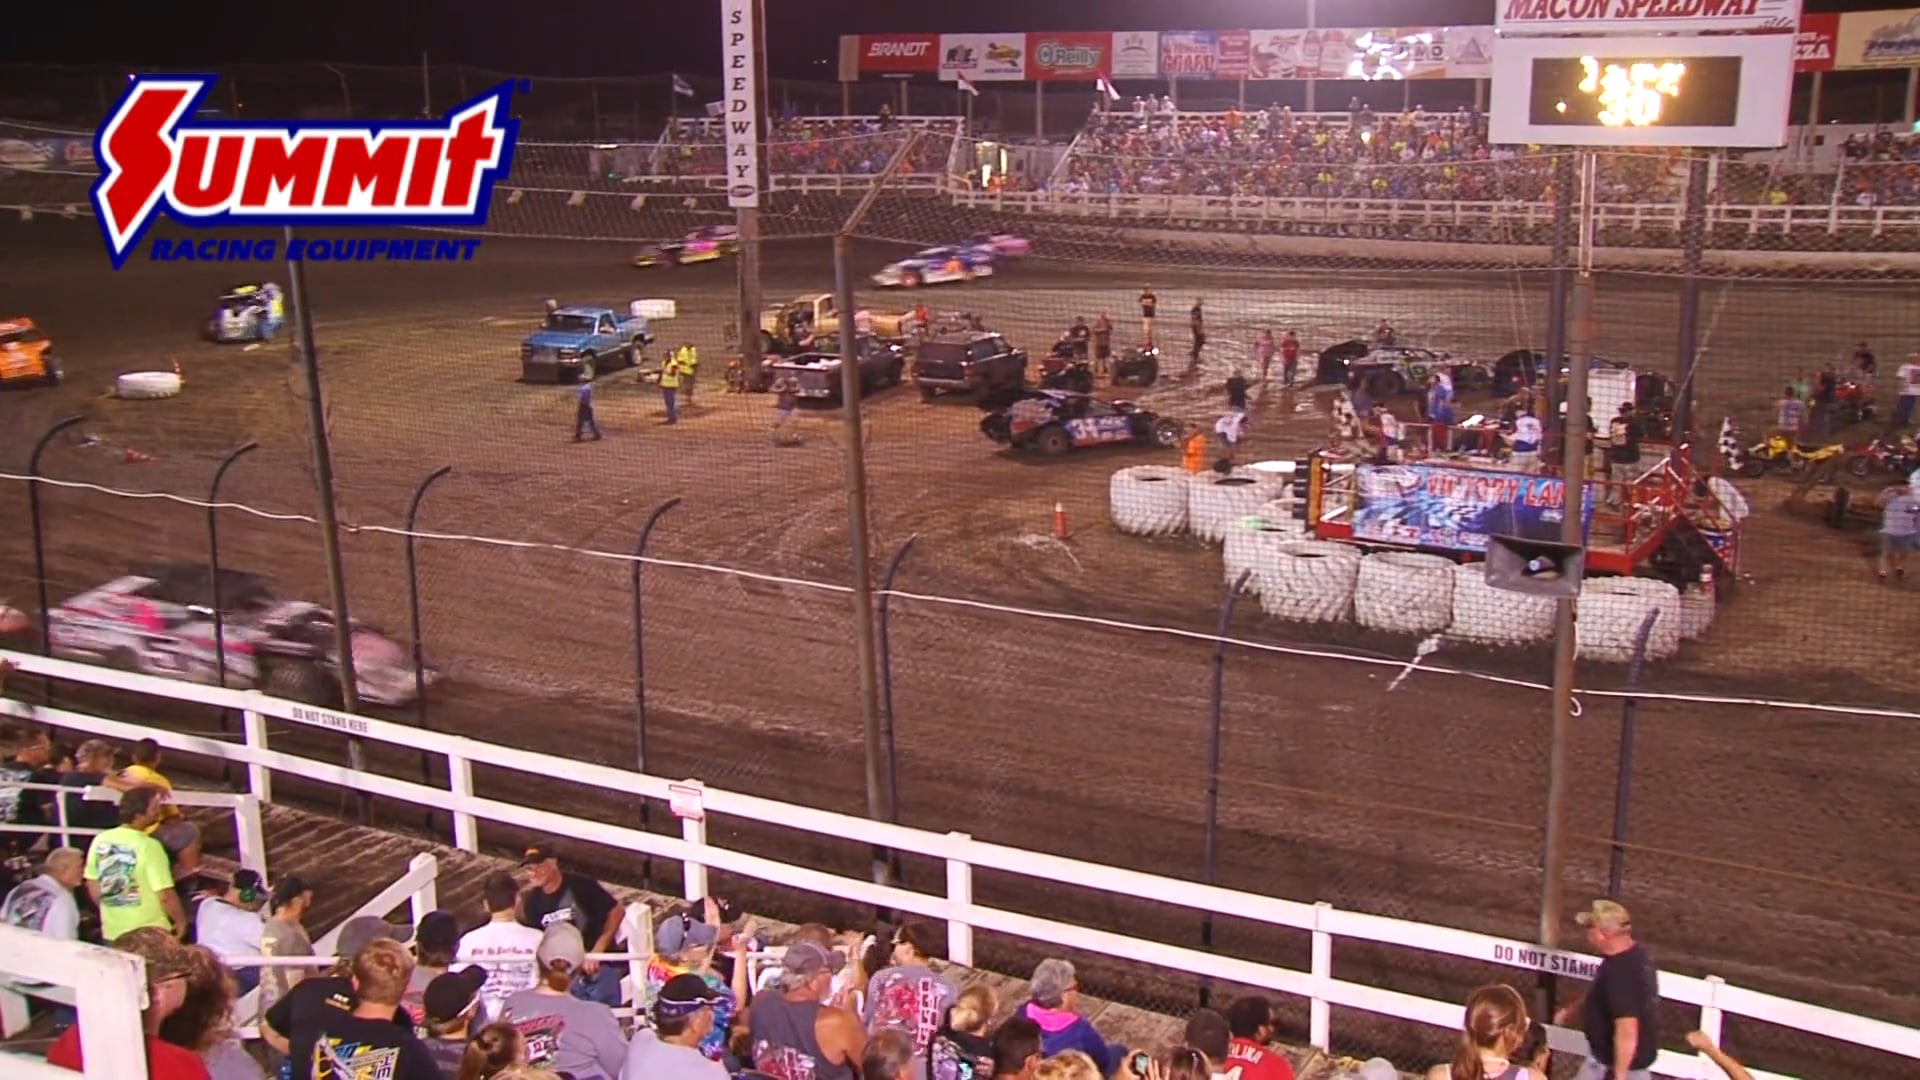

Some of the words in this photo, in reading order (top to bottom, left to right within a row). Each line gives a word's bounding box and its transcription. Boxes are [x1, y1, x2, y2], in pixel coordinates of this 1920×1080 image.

[1504, 0, 1609, 19] MACON
[1615, 0, 1760, 18] SPEEDWAY
[867, 42, 931, 56] BRANDT
[731, 11, 751, 178] SPEEDWAY
[1427, 474, 1520, 503] VICTORY
[1524, 479, 1566, 507] LAN
[1494, 944, 1513, 961] DO
[1519, 949, 1547, 967] NOT
